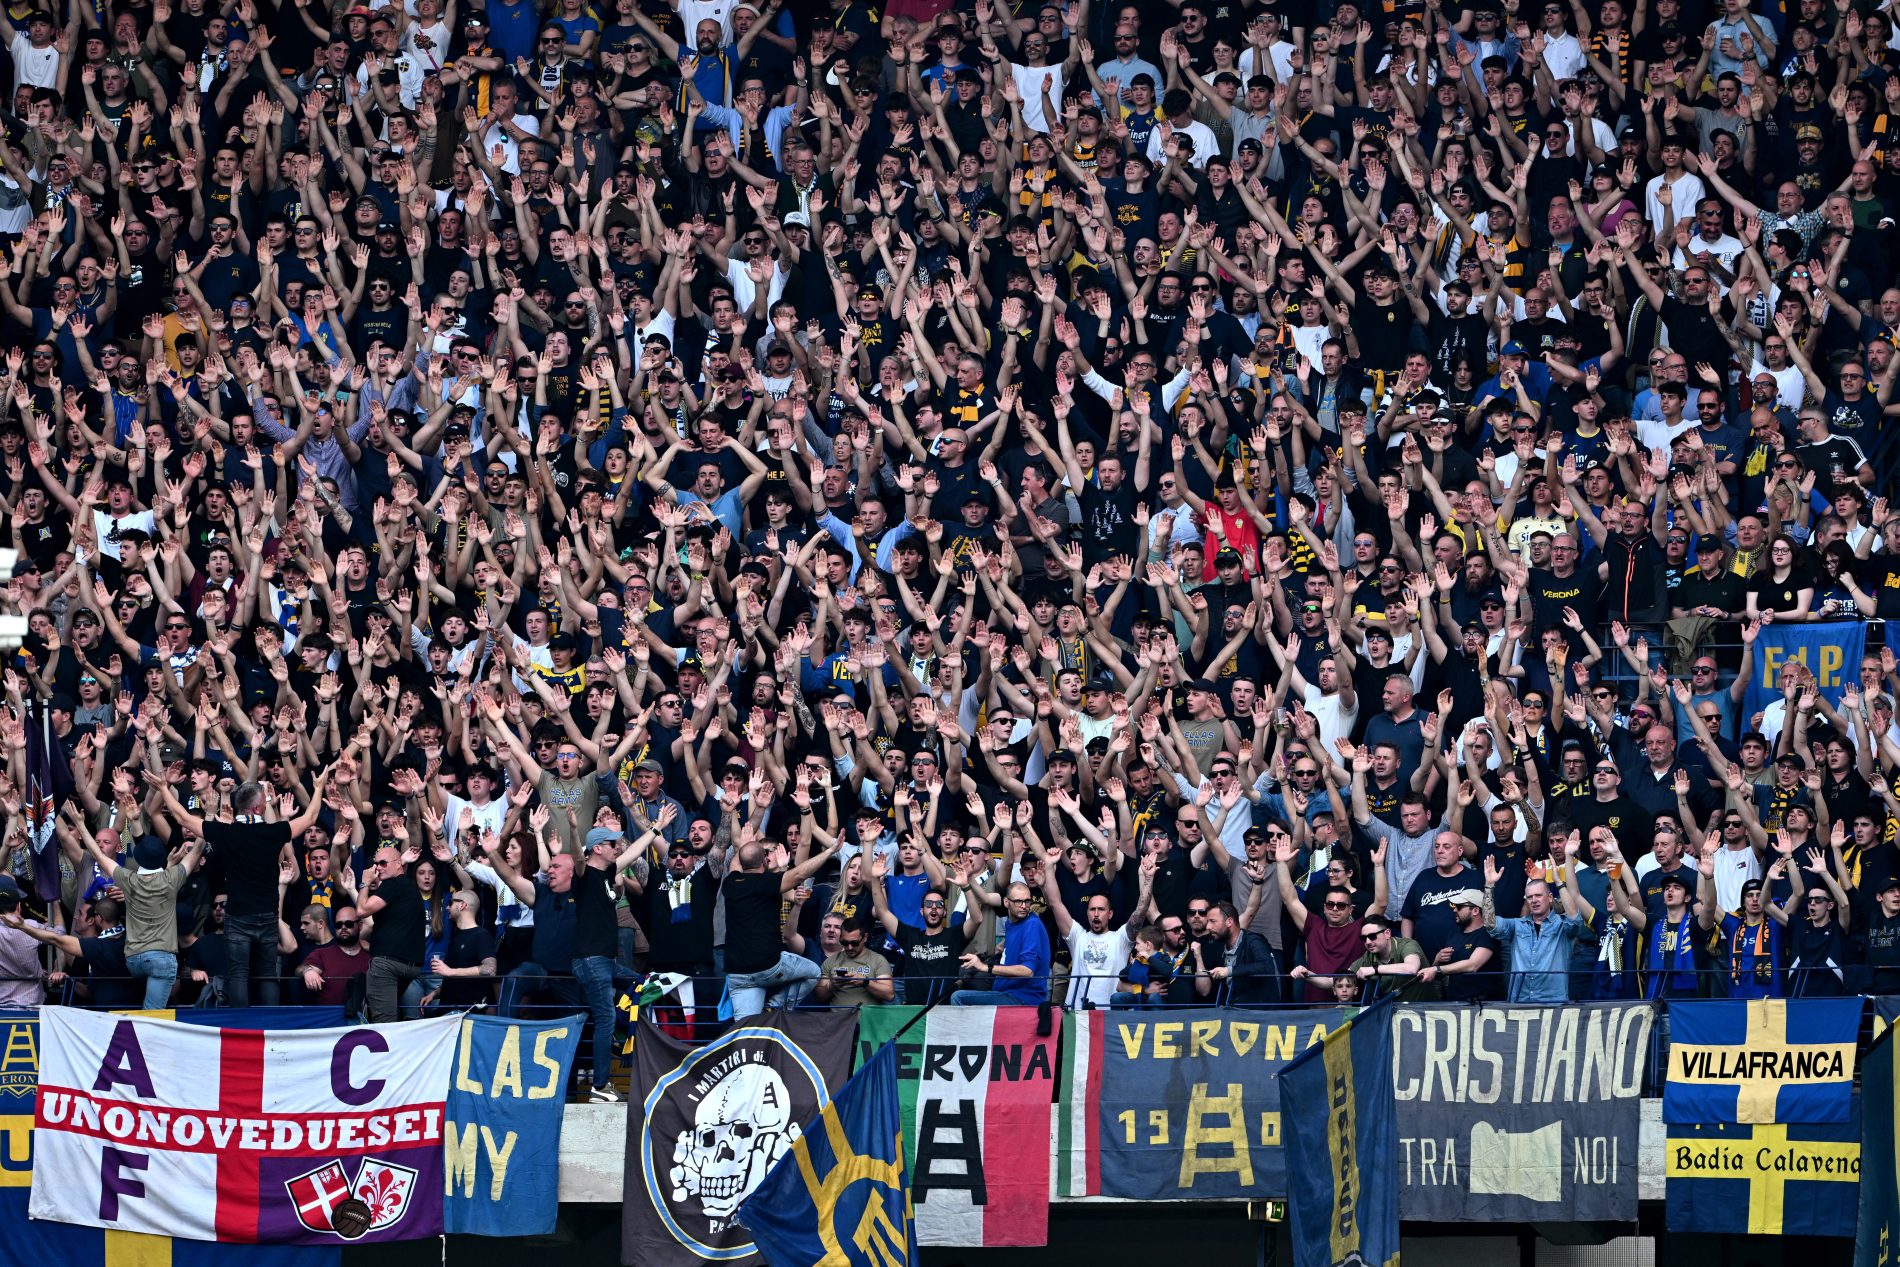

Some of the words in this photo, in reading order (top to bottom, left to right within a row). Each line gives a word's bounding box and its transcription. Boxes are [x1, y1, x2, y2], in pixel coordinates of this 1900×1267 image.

[1754, 289, 1765, 326] ELLA
[1542, 588, 1580, 599] VERONA
[1183, 731, 1215, 739] ELLAS
[1187, 739, 1209, 747] RMY
[92, 1020, 157, 1098] A
[330, 1028, 390, 1106] C
[695, 1048, 747, 1095] MARTIRI
[1392, 1005, 1655, 1104] CRISTIANO
[1682, 1051, 1844, 1079] VILLAFRANCA
[1, 1073, 38, 1084] ERON
[42, 1091, 441, 1151] UNONOVEDUESEI
[1118, 1109, 1169, 1145] 19
[444, 1120, 519, 1201] MY
[1399, 1138, 1458, 1186] TRA
[1574, 1136, 1618, 1184] NOI
[1675, 1146, 1744, 1170] Badia
[1756, 1147, 1861, 1174] Calavena
[98, 1146, 150, 1222] F
